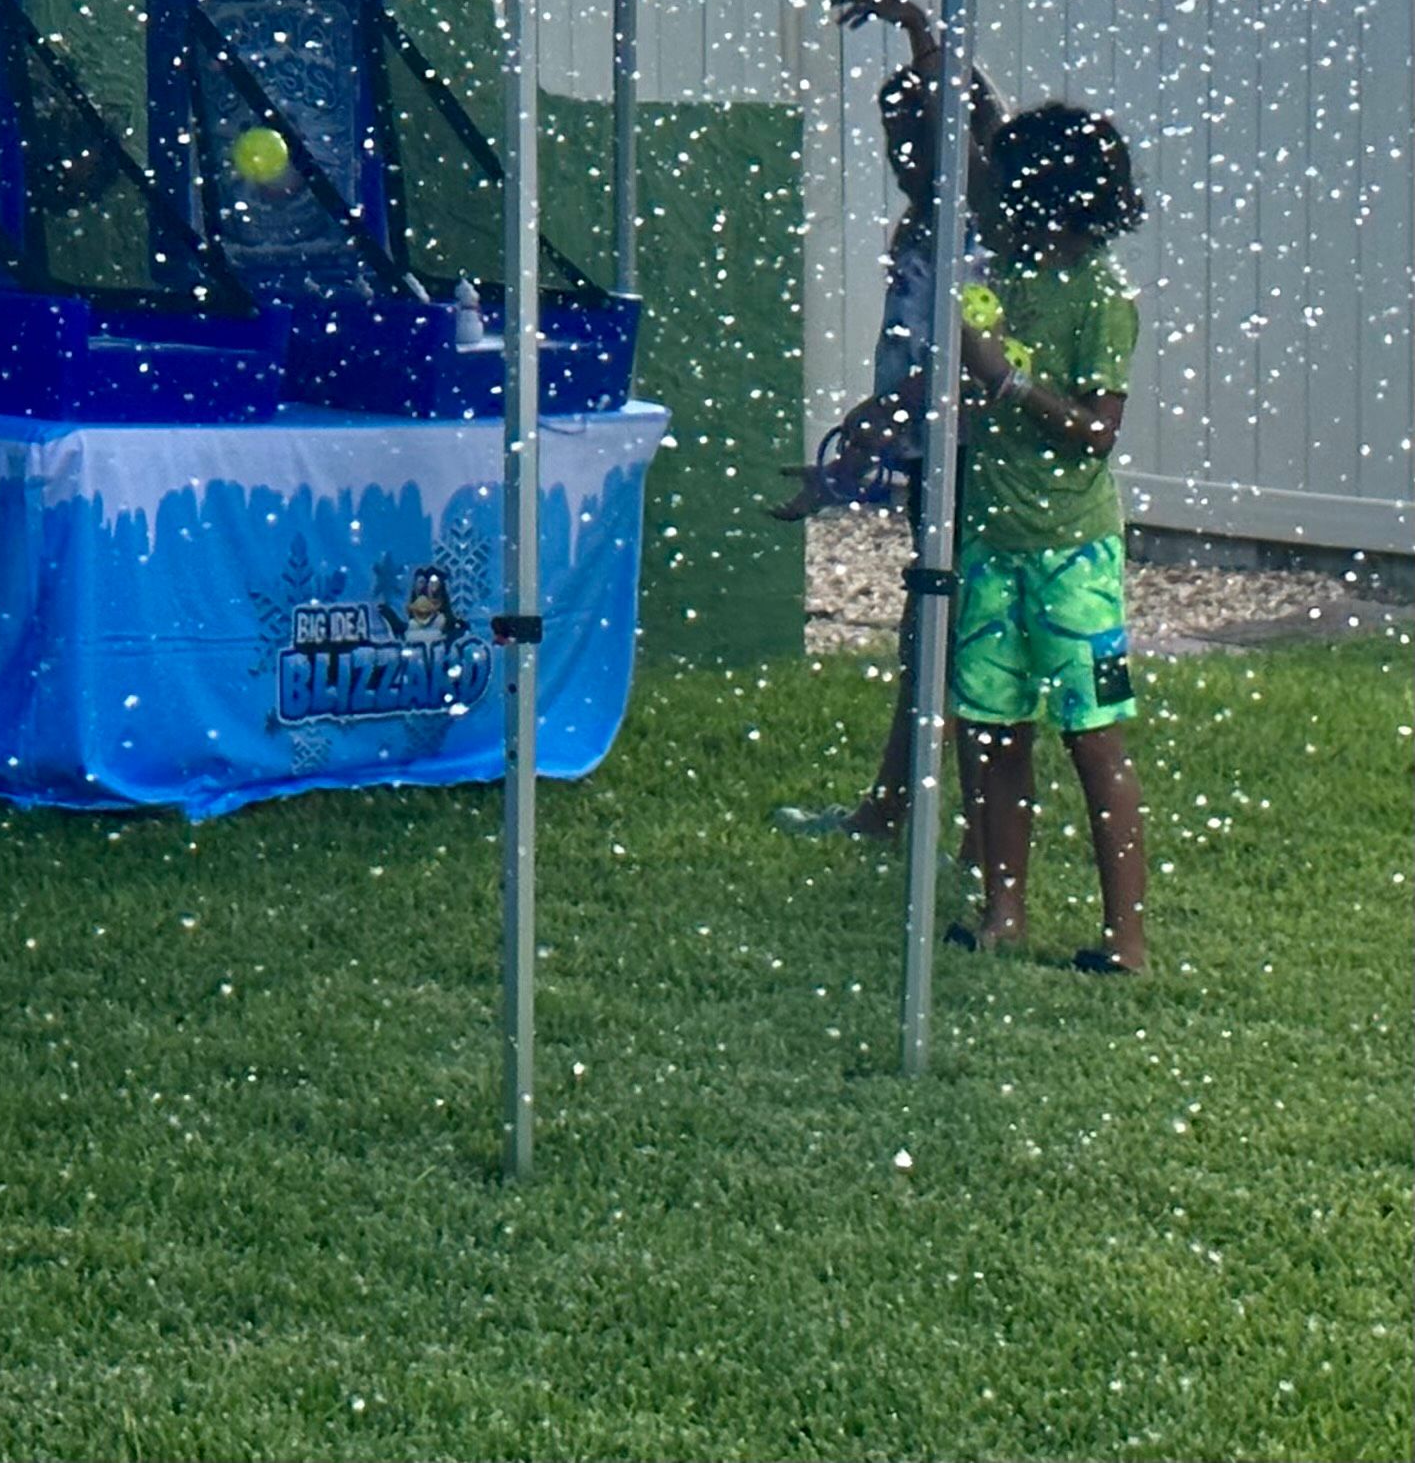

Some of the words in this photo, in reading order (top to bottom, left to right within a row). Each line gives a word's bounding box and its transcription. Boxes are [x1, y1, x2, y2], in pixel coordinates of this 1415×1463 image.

[296, 607, 326, 643] BIG
[330, 606, 368, 642] IDEA
[280, 640, 488, 718] BLIZZARD
